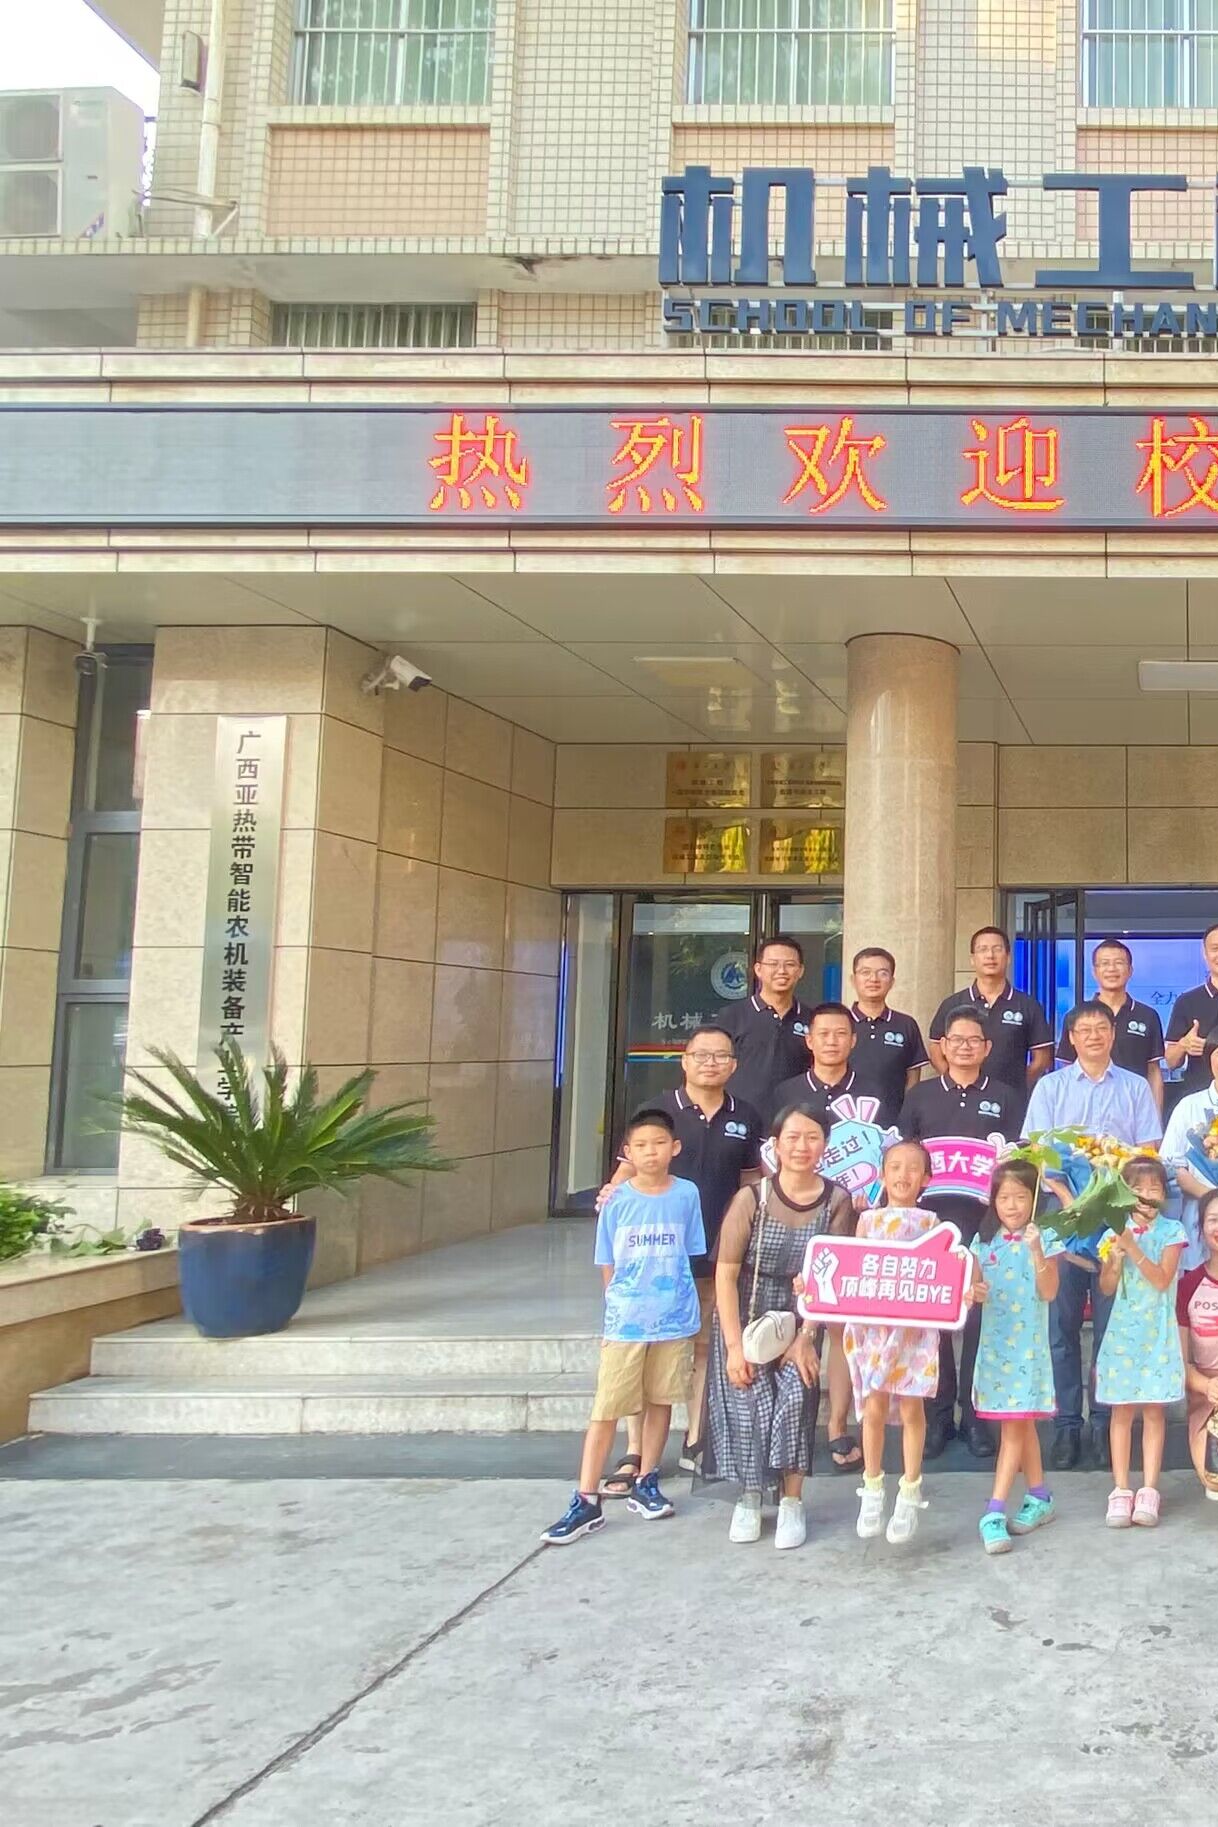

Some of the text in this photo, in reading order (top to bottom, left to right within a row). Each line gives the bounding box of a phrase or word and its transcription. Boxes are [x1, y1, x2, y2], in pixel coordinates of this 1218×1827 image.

[663, 299, 879, 334] SCHOOL
[905, 301, 974, 334] OF
[652, 1012, 719, 1030] 机械
[628, 1233, 676, 1248] SUMMER
[861, 1253, 937, 1280] 各自努力
